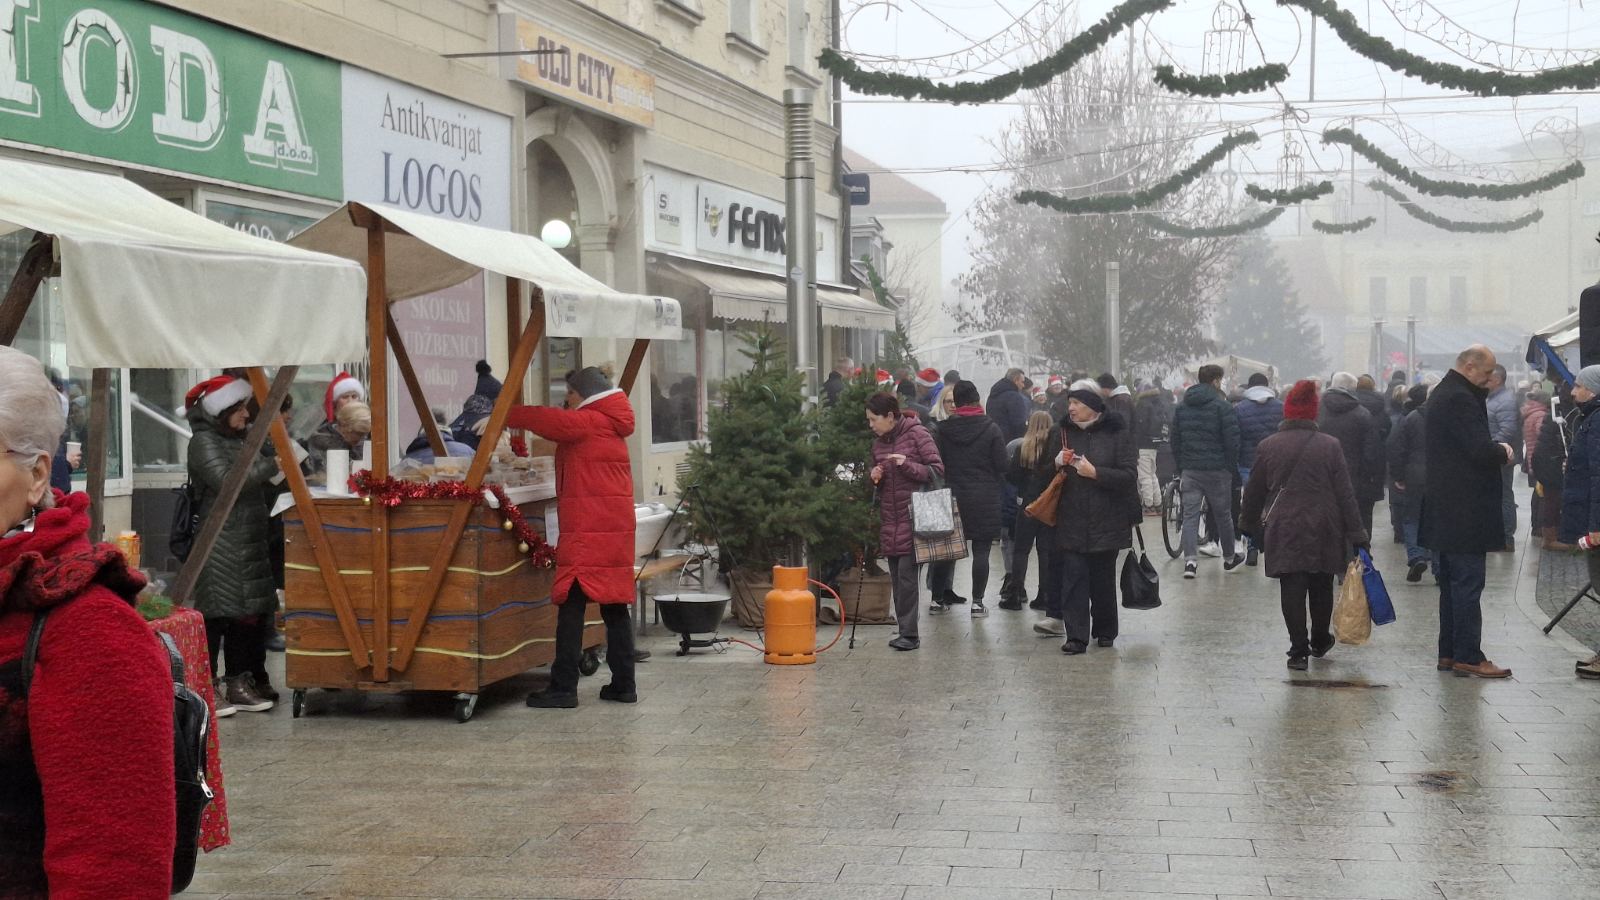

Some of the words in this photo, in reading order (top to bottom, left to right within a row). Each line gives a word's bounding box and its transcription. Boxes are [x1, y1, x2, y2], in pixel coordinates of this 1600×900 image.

[537, 35, 571, 88] OLD
[577, 52, 615, 104] CITY
[277, 143, 312, 161] d.o.o.
[381, 91, 482, 161] Antikvarijat
[382, 151, 482, 222] LOGOS
[424, 364, 458, 392] otkup
